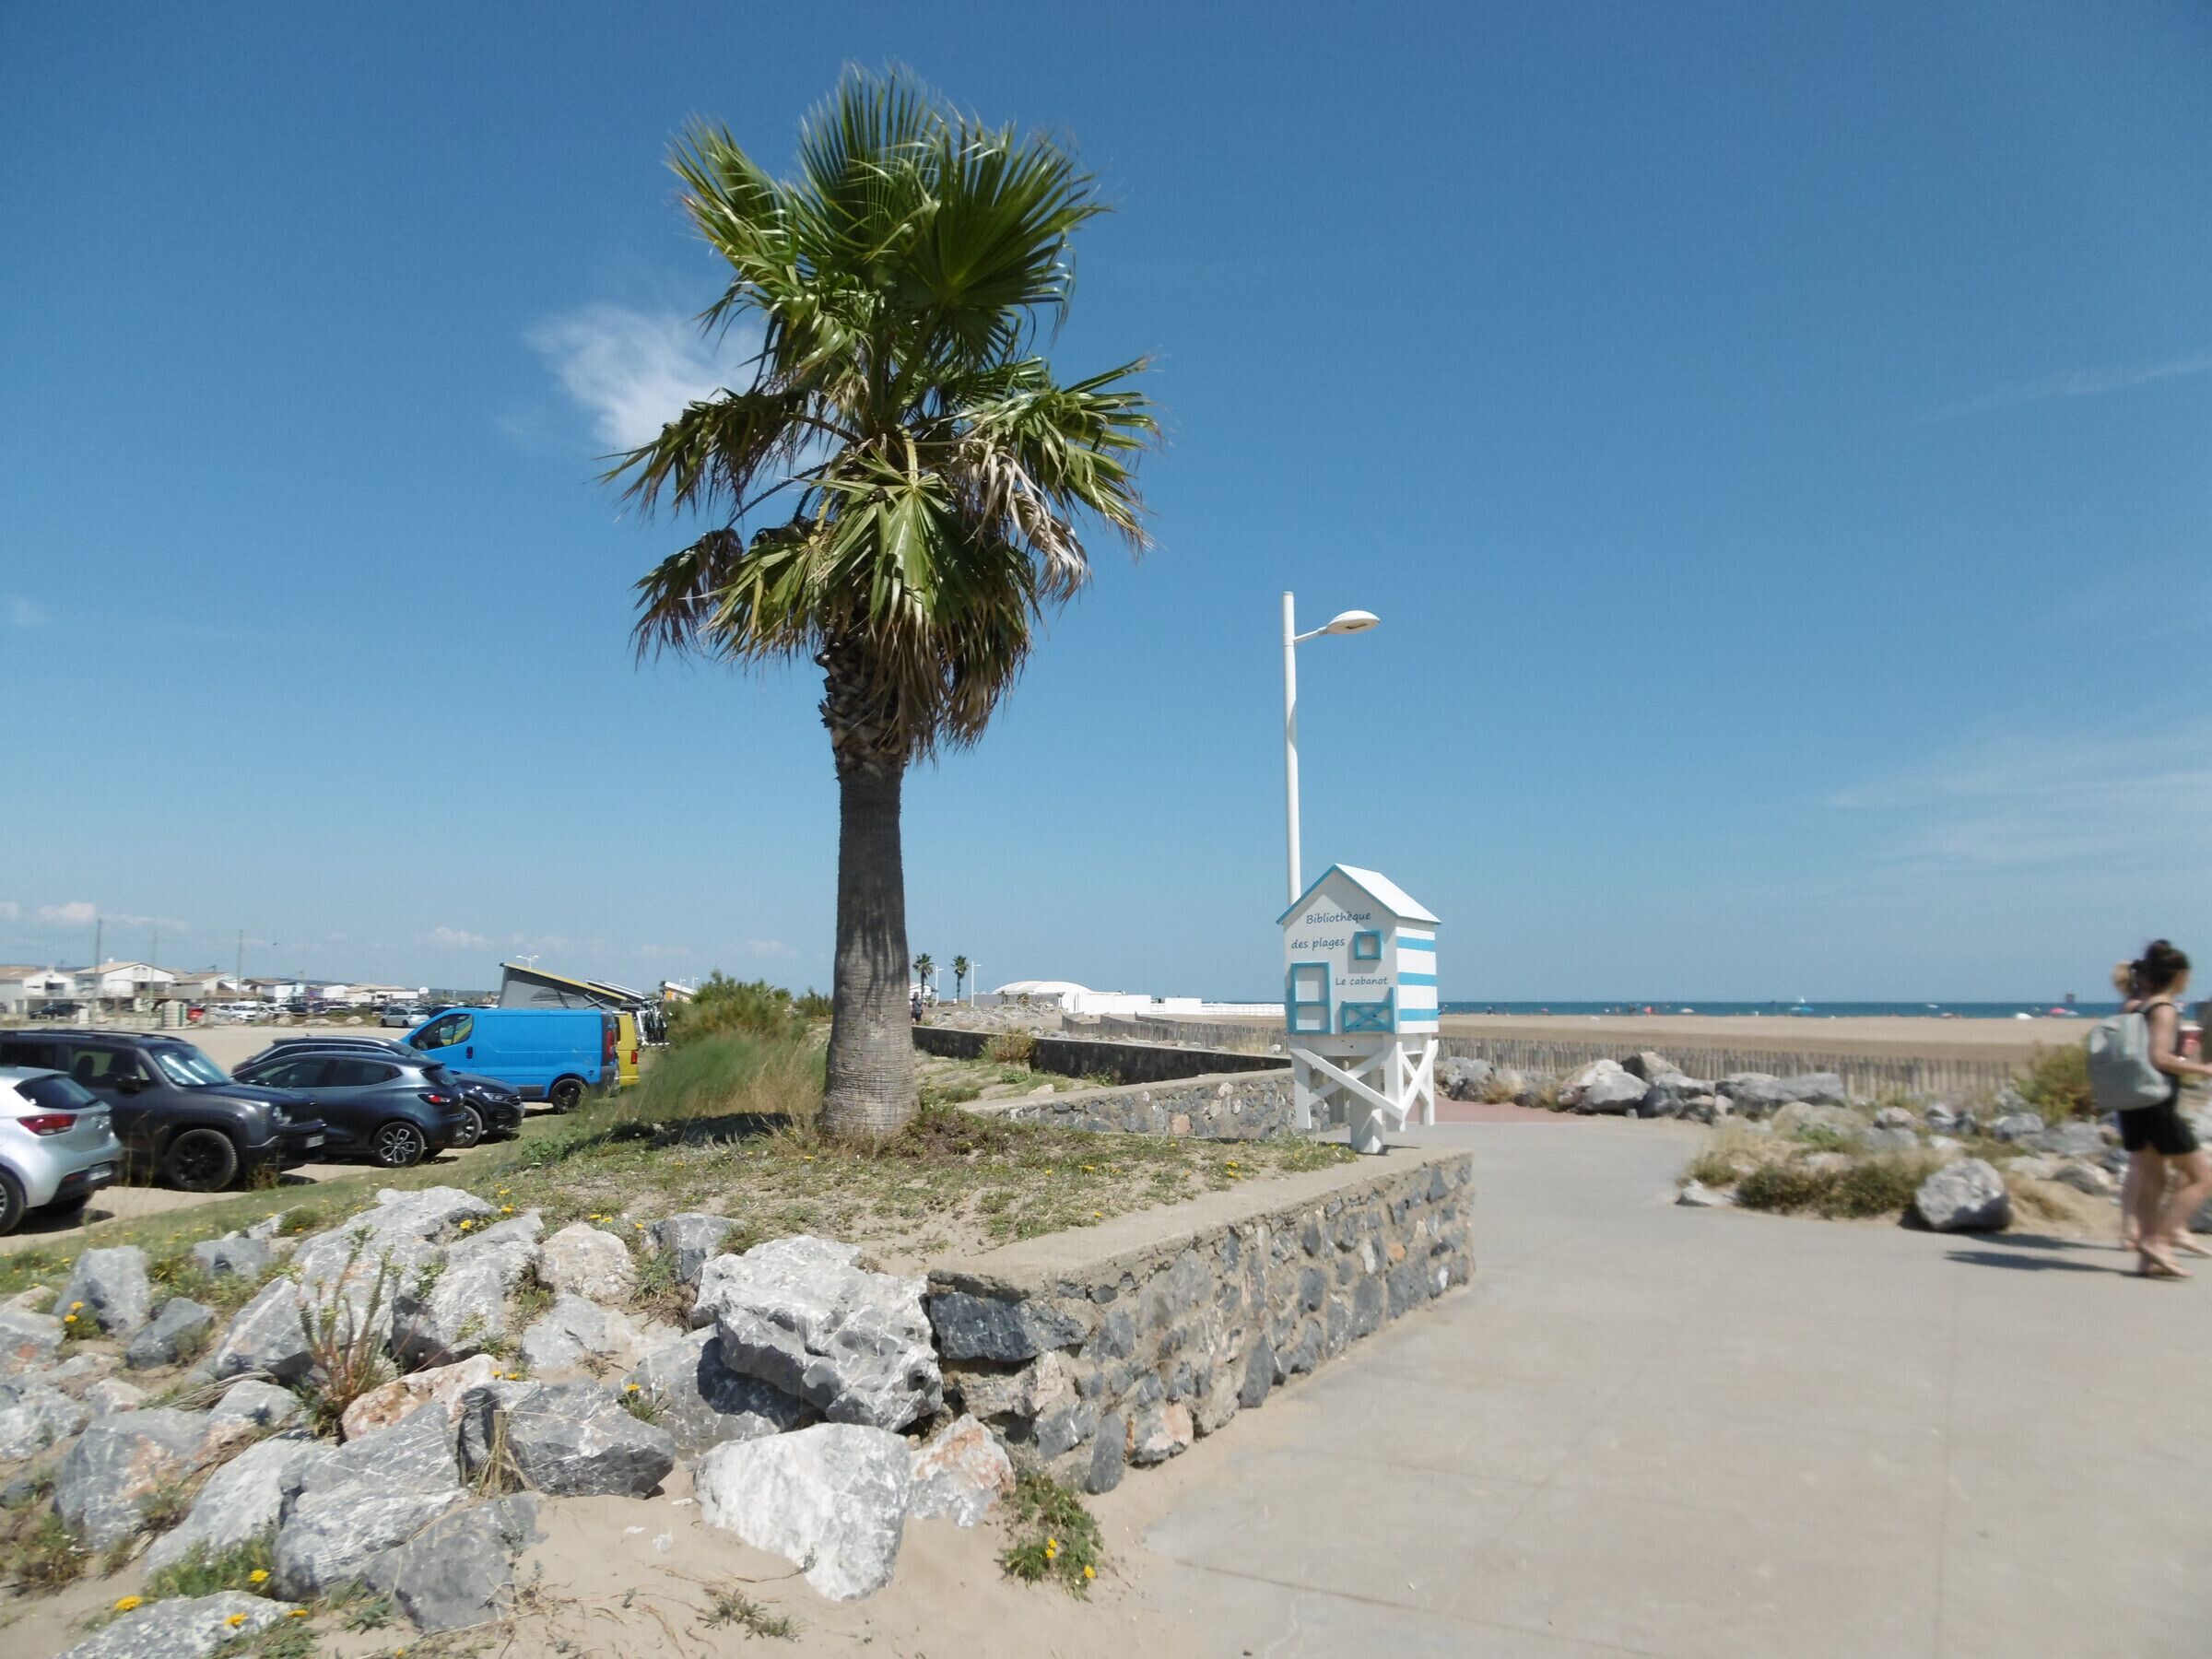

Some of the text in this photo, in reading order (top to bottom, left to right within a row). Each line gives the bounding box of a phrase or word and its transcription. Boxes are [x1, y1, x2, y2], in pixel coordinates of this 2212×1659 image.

[1306, 911, 1371, 924] Bibliothèque
[1291, 936, 1346, 951] des plages
[1335, 975, 1388, 986] Le cabanot
